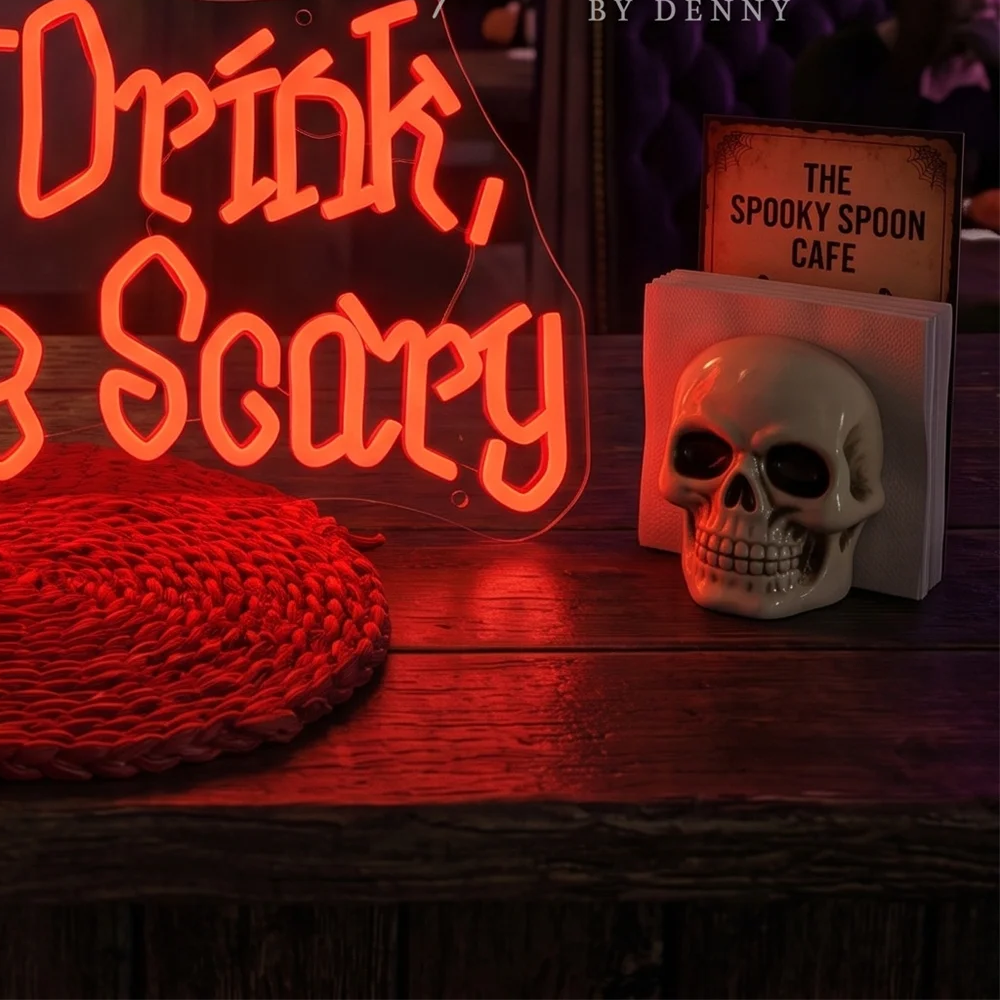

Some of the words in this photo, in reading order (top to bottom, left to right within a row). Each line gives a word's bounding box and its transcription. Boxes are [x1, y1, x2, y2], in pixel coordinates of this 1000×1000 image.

[803, 162, 853, 196] THE
[730, 194, 831, 232] SPOOKY
[837, 203, 926, 241] SPOON
[791, 237, 856, 274] CAFE
[98, 234, 565, 515] Scary
